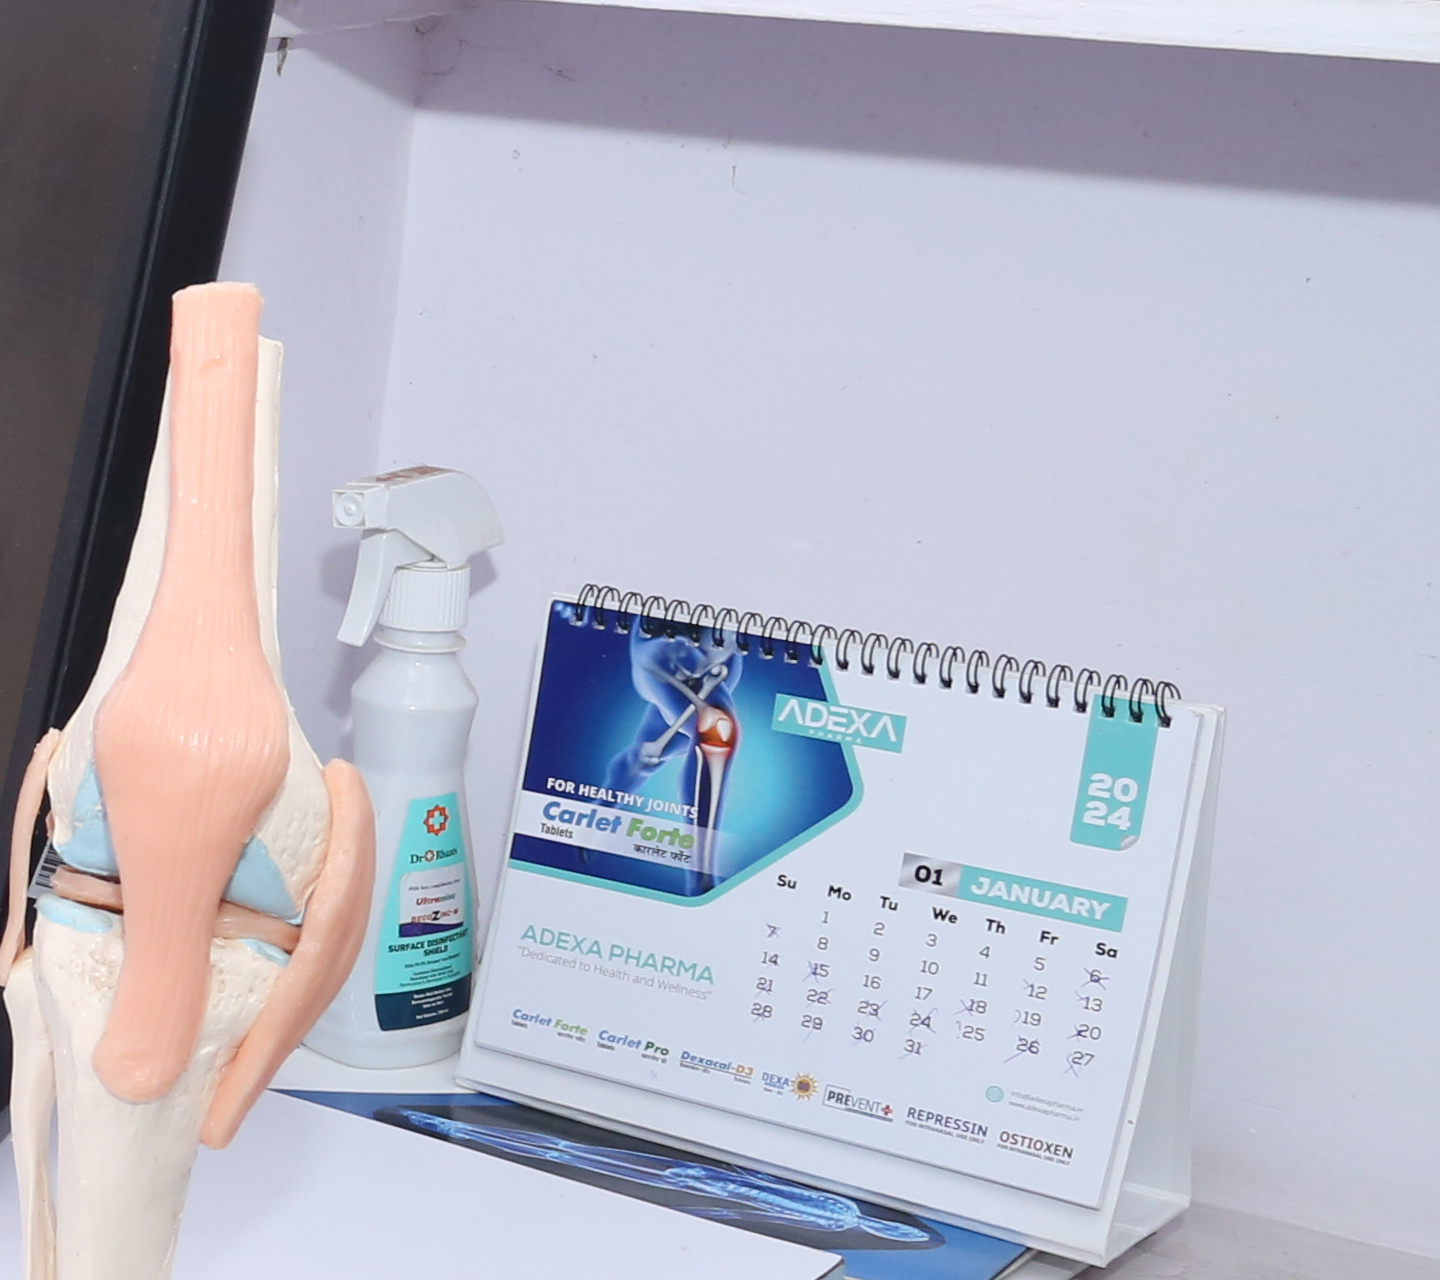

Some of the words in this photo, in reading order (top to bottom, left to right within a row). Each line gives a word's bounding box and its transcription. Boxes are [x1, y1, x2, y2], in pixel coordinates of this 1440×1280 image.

[778, 698, 897, 742] ADEXA
[809, 729, 862, 744] PHARMA
[547, 777, 575, 794] FOR
[579, 783, 644, 808] HEALTHY
[646, 798, 699, 819] JOINTS
[1087, 773, 1138, 803] 20
[540, 822, 574, 839] Tablets
[543, 801, 622, 834] Carlet
[626, 818, 695, 849] Forte
[1082, 800, 1131, 831] 24
[914, 865, 944, 886] 01
[970, 877, 1111, 920] JANUARY
[776, 874, 797, 890] Su
[827, 885, 852, 901] Mo
[880, 895, 899, 911] Tu
[932, 906, 958, 924] We
[985, 918, 1006, 934] Th
[1039, 930, 1059, 946] Fr
[1095, 942, 1118, 959] Sa
[520, 924, 604, 959] ADEXA
[608, 944, 714, 985] PHARMA
[821, 911, 829, 924] 1
[873, 922, 886, 936] 2
[925, 933, 938, 947] 3
[979, 945, 991, 959] 4
[1033, 957, 1046, 971] 5
[1089, 969, 1102, 983] 6
[580, 961, 591, 972] to
[593, 964, 630, 982] Health
[632, 974, 654, 988] and
[767, 924, 777, 938] 7
[817, 937, 829, 950] 8
[868, 948, 880, 962] 9
[920, 960, 940, 975] 10
[973, 972, 988, 987] 11
[1028, 984, 1048, 1000] 12
[1083, 996, 1103, 1012] 13
[761, 951, 779, 966] 14
[812, 963, 830, 978] 15
[862, 974, 882, 990] 16
[914, 986, 933, 1001] 17
[968, 999, 988, 1014] 18
[1021, 1011, 1042, 1027] 19
[1079, 1024, 1102, 1040] 20
[512, 1008, 552, 1027] Carlet
[554, 1019, 588, 1036] Forte
[750, 1002, 773, 1019] 28
[800, 1014, 823, 1030] 29
[851, 1026, 875, 1043] 30
[903, 1039, 922, 1055] 31
[756, 977, 774, 992] 21
[806, 989, 829, 1005] 22
[857, 1000, 880, 1017] 23
[909, 1012, 932, 1028] 24
[962, 1025, 986, 1042] 25
[1016, 1038, 1041, 1055] 26
[1071, 1051, 1095, 1067] 27
[598, 1029, 642, 1050] Carlet
[644, 1041, 670, 1056] Pro
[681, 1050, 754, 1077] Dexacal-D3
[761, 1072, 790, 1088] DEXA
[827, 1090, 882, 1114] PREVENT
[906, 1107, 989, 1138] REPRESSIN
[999, 1131, 1074, 1159] OSTIOXEN
